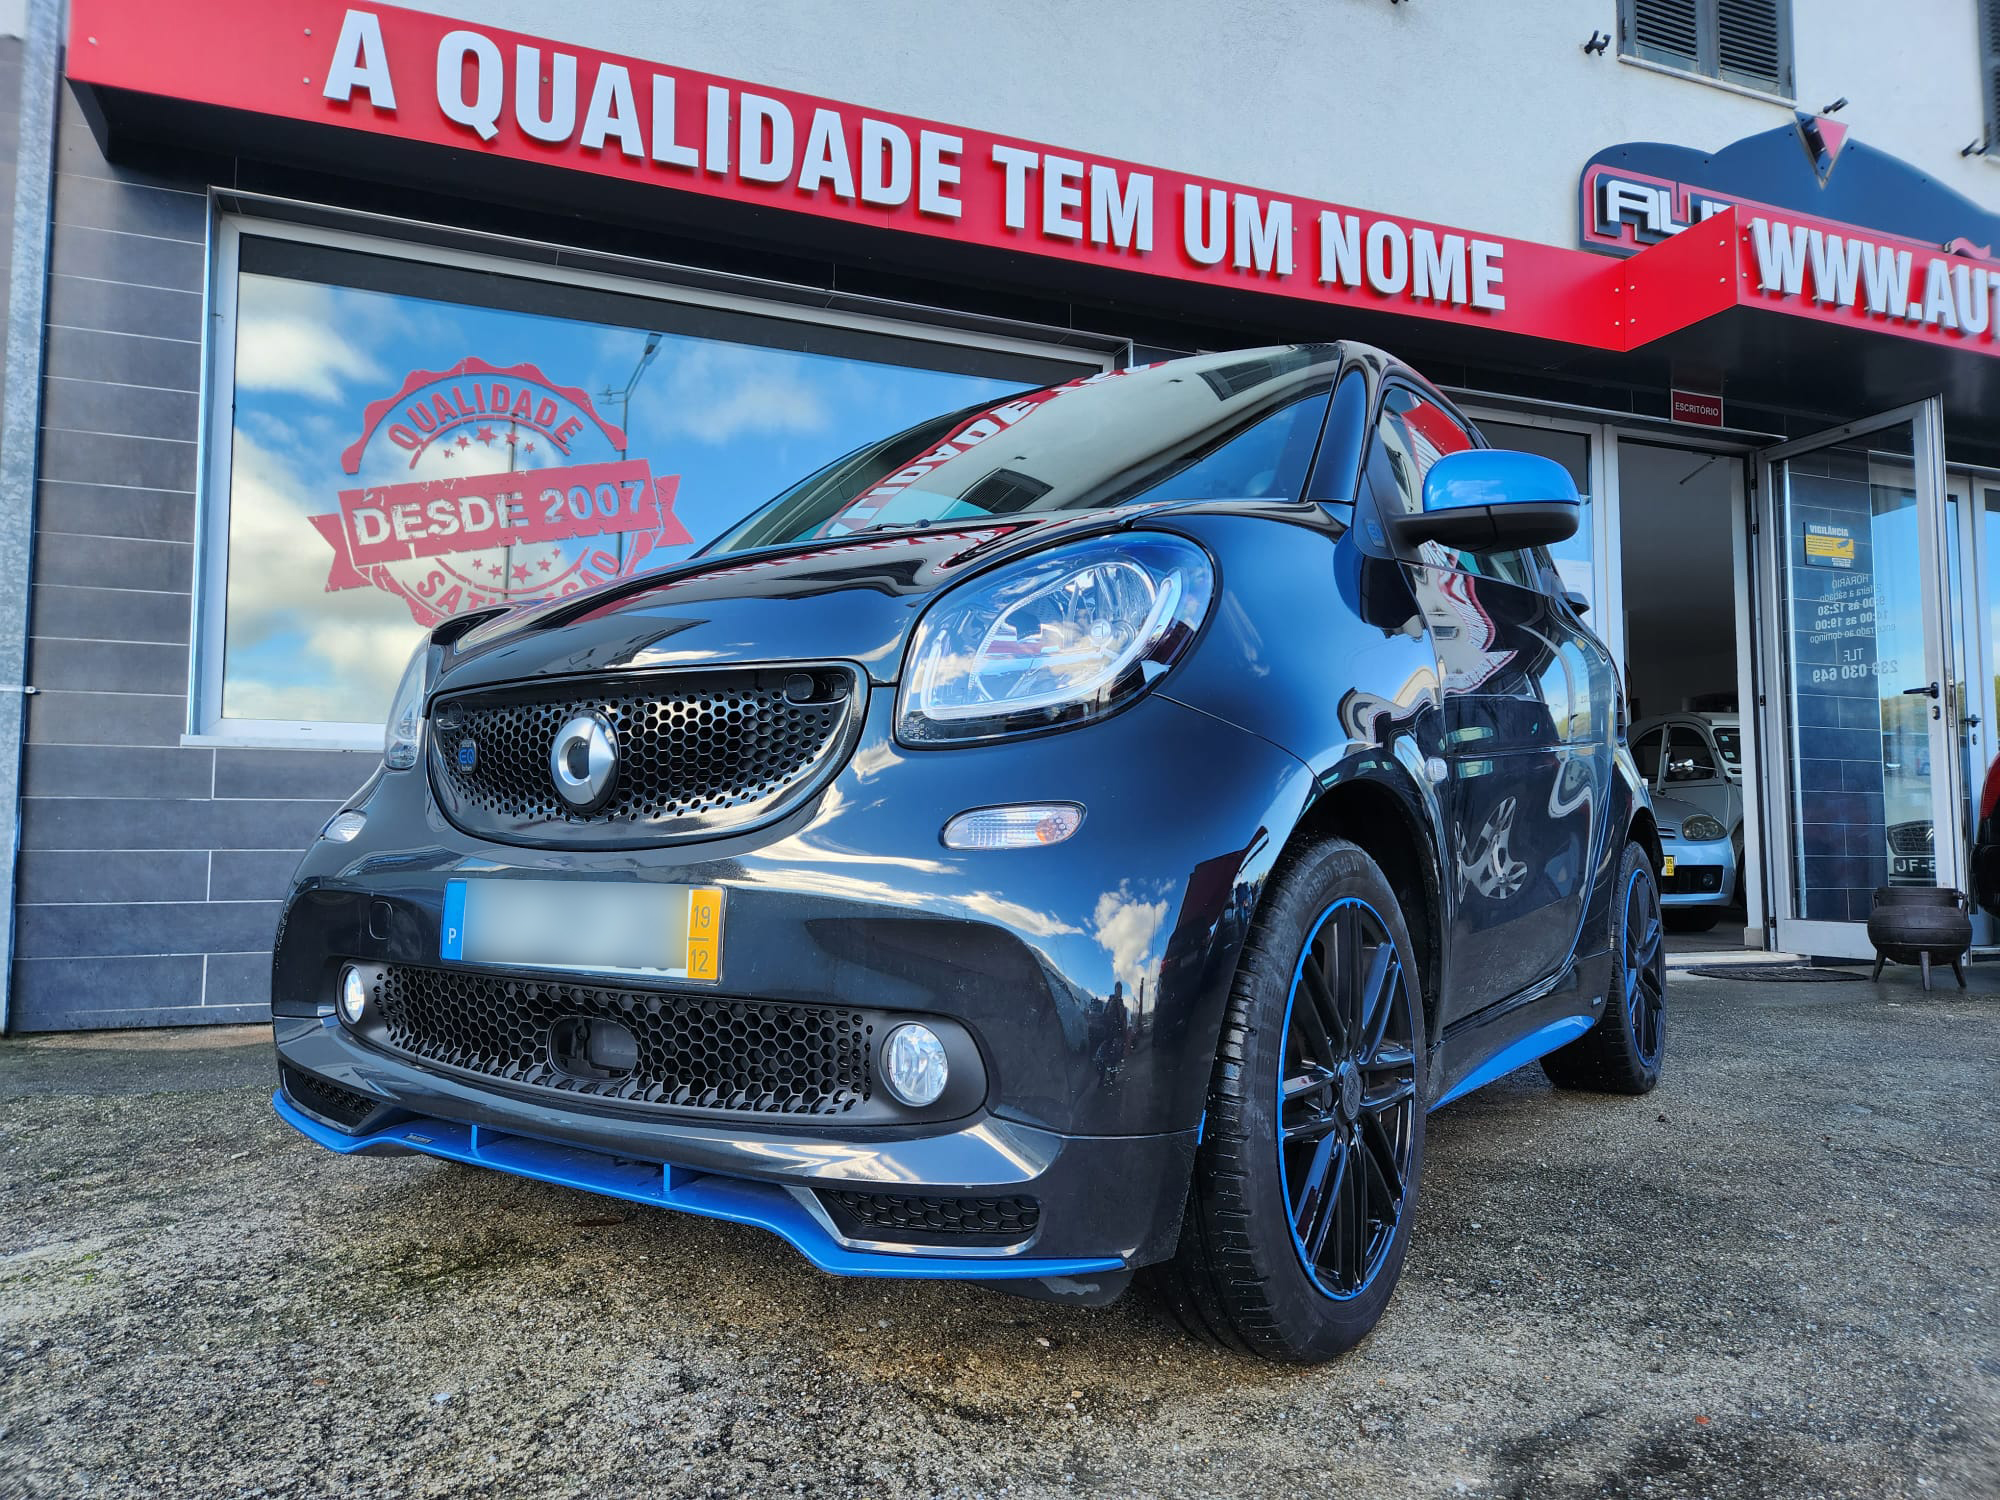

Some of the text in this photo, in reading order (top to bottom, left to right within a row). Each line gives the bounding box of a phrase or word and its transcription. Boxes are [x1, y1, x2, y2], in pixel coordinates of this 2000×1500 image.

[323, 9, 1506, 311] A QUALIDADE TEM UM NOME
[388, 383, 584, 451] QUALIDADE
[1675, 402, 1719, 417] ESCRITÓRIO
[352, 479, 646, 547] DESDE 2007
[694, 905, 711, 929] 19
[448, 927, 457, 944] P
[691, 949, 709, 972] 12
